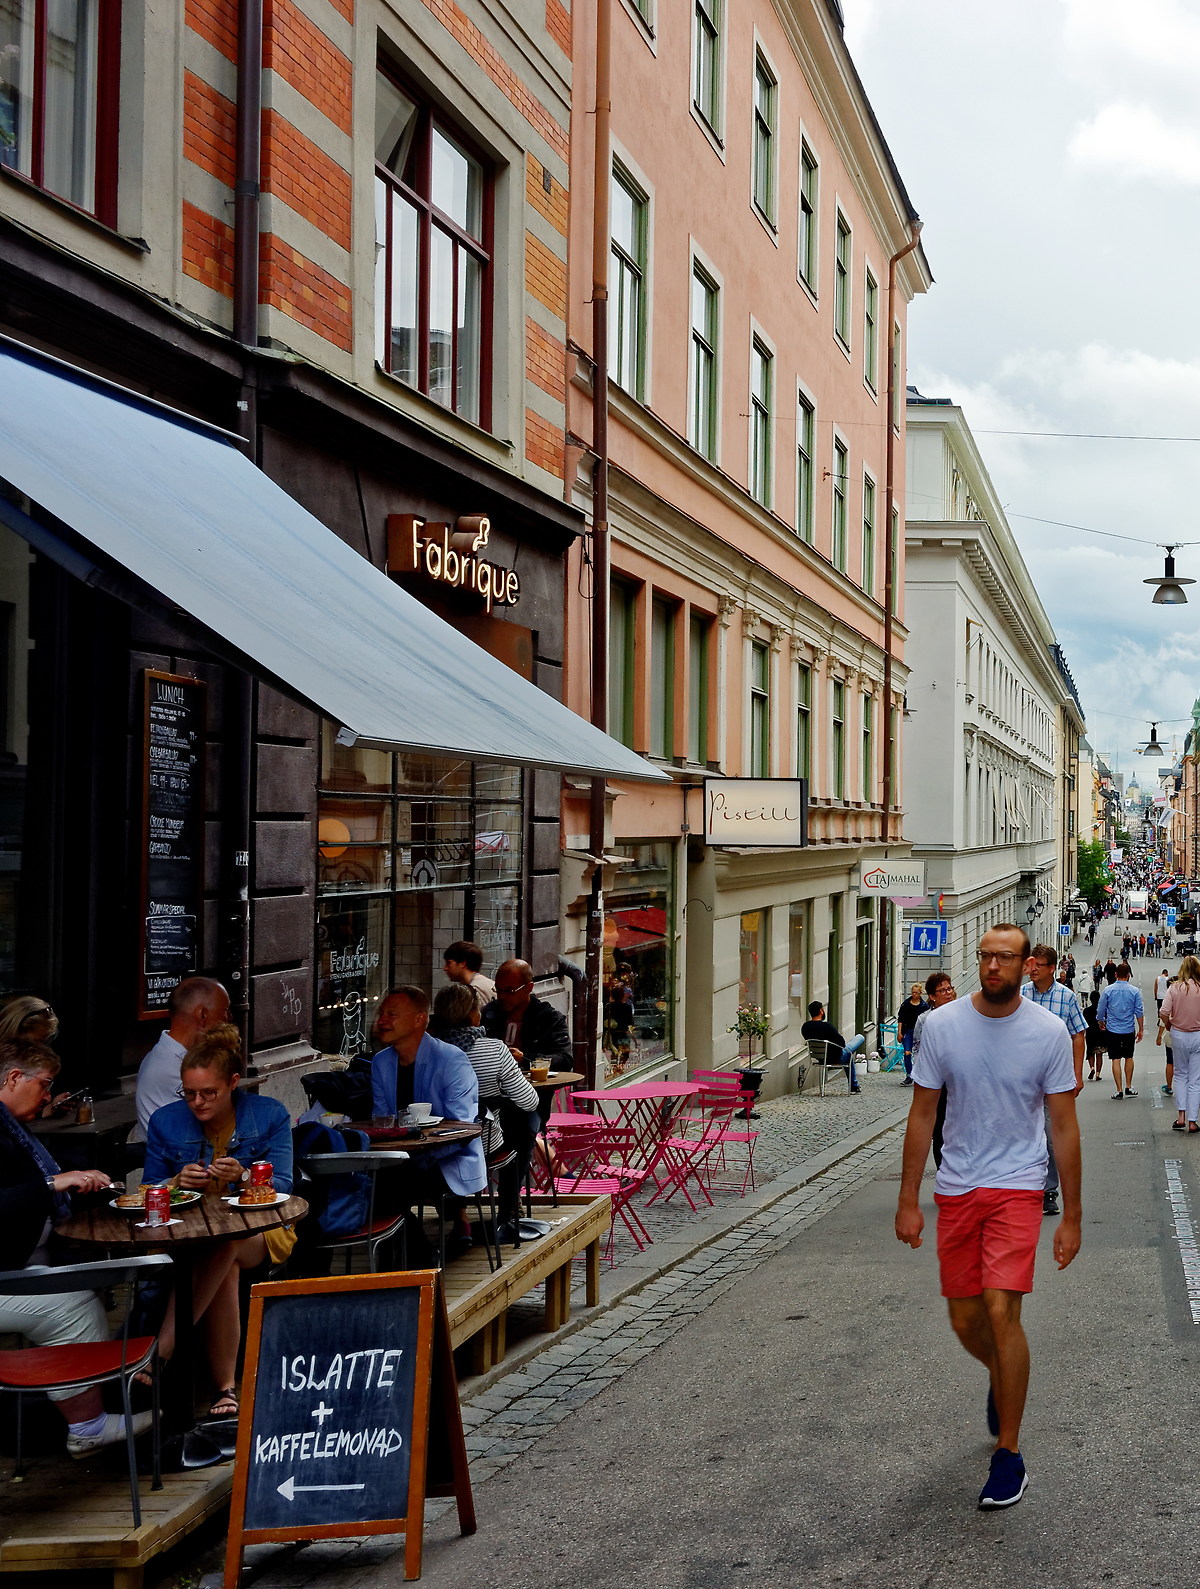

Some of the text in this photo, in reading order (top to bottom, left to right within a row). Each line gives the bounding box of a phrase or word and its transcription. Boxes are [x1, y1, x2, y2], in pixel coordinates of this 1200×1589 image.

[413, 518, 519, 613] Fabrique
[156, 683, 185, 704] LUNCH
[709, 790, 799, 835] Pistill
[890, 875, 921, 883] MAHAL
[329, 942, 380, 976] Fabrique
[281, 1349, 403, 1392] ISLATTE
[255, 1427, 403, 1464] KAFFELEMONAD
